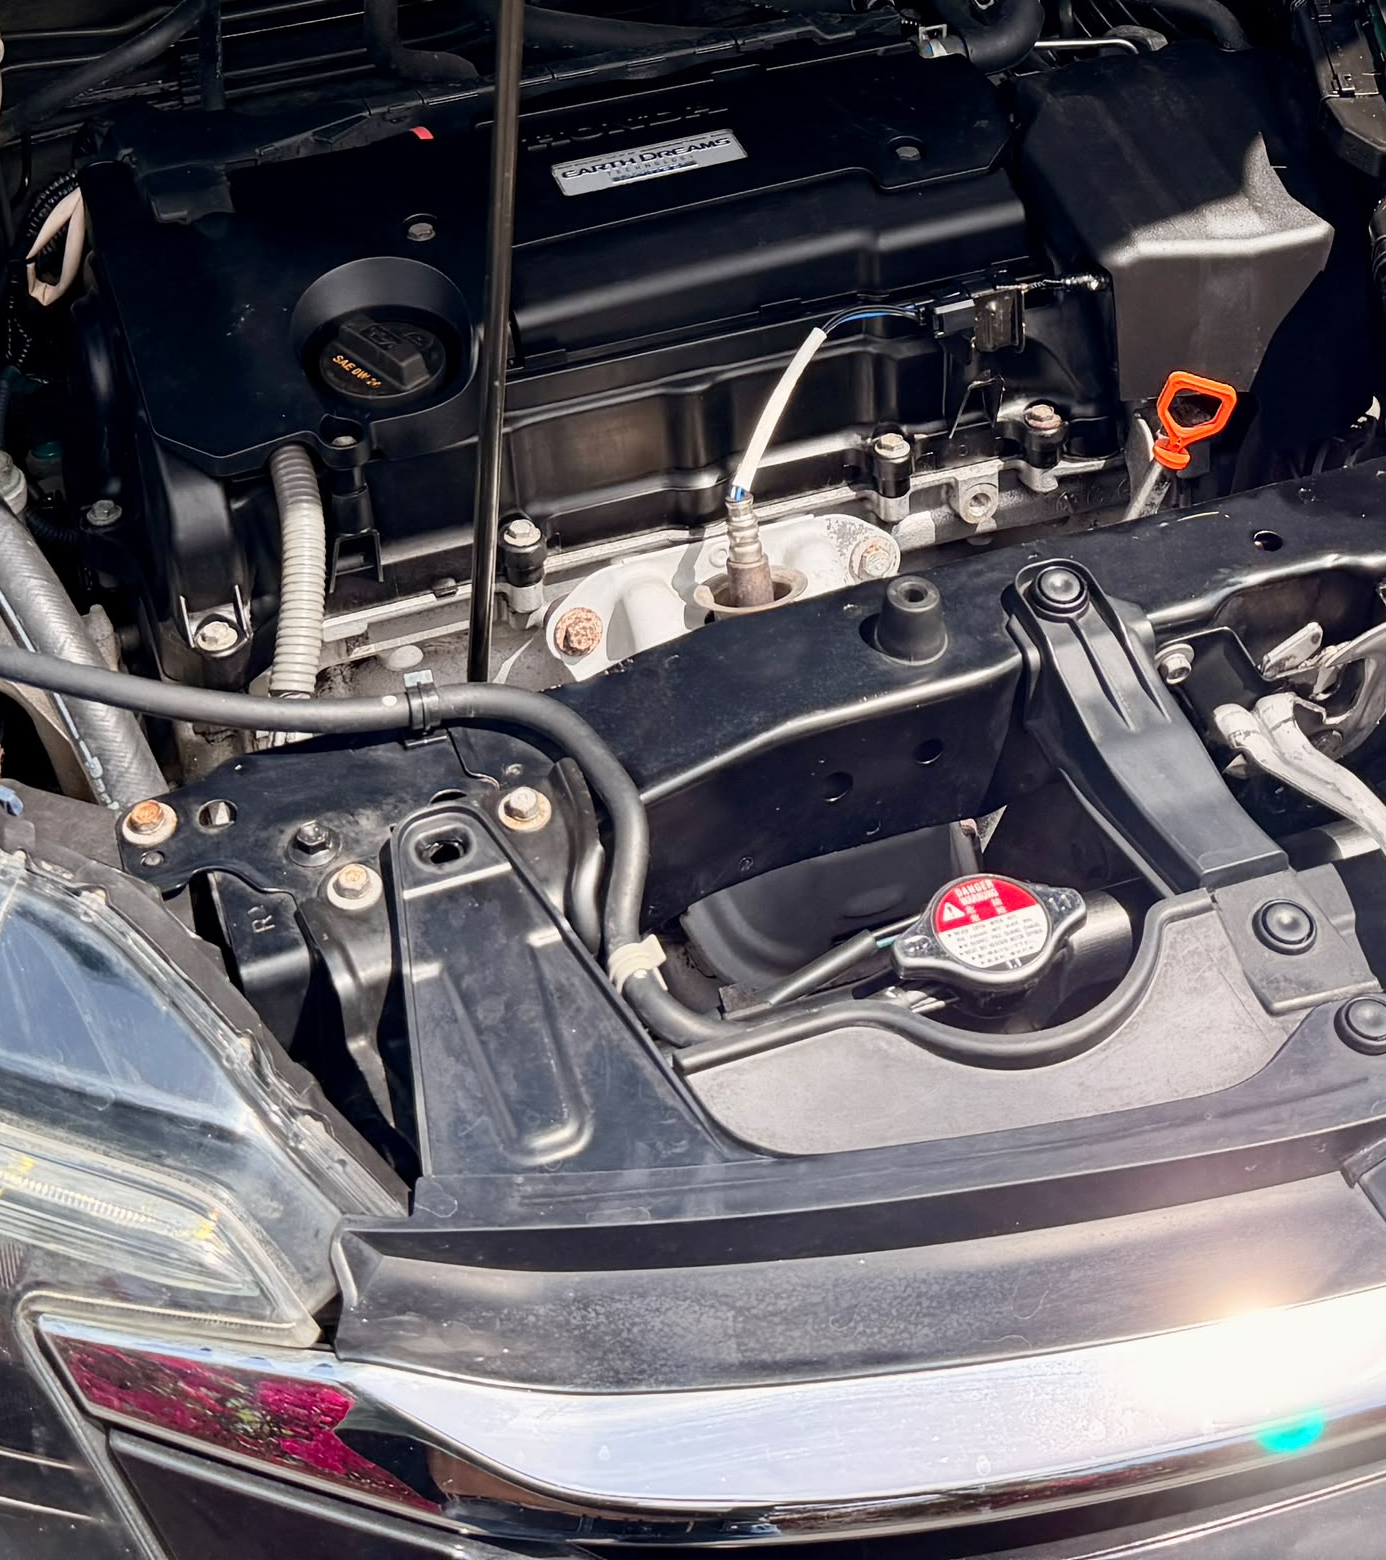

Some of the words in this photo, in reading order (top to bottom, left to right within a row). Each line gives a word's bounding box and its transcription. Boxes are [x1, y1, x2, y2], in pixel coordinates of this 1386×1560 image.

[561, 155, 637, 179] EARTH
[332, 354, 357, 371] SAE
[954, 879, 995, 898] DANGER
